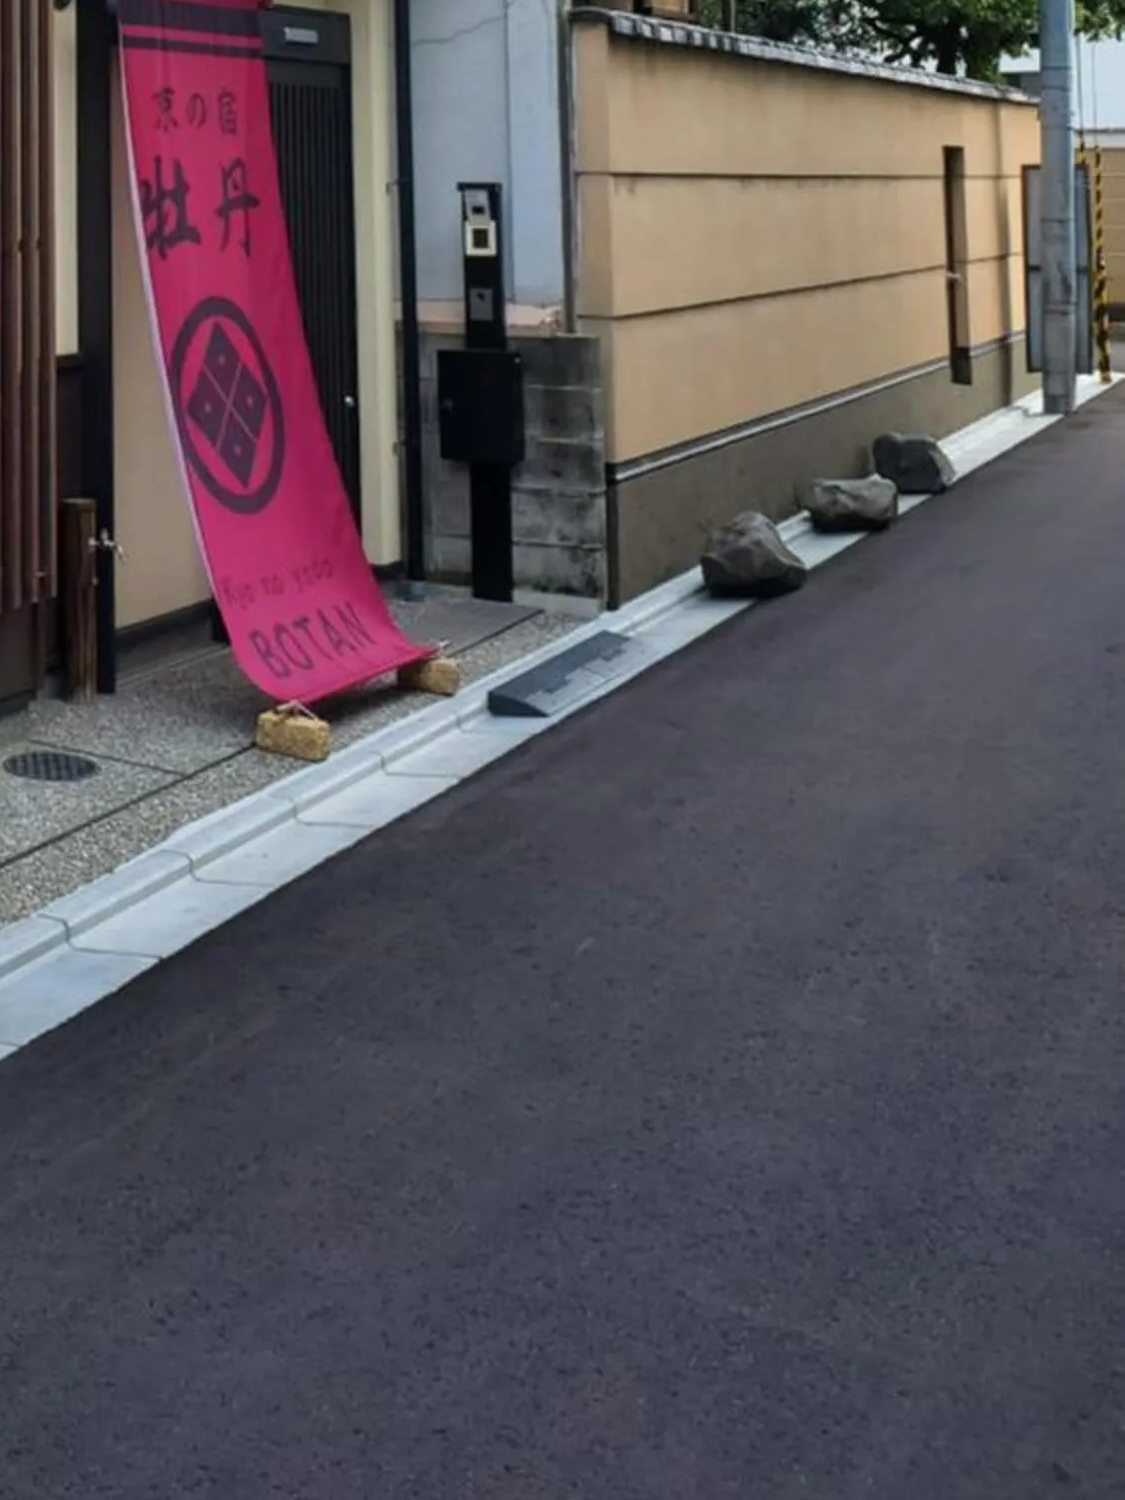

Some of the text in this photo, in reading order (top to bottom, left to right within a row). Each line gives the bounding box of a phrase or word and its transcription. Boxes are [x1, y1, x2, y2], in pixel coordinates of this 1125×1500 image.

[151, 86, 238, 136] 京の宿
[139, 153, 262, 260] 牡丹
[248, 600, 378, 678] BOTAN
